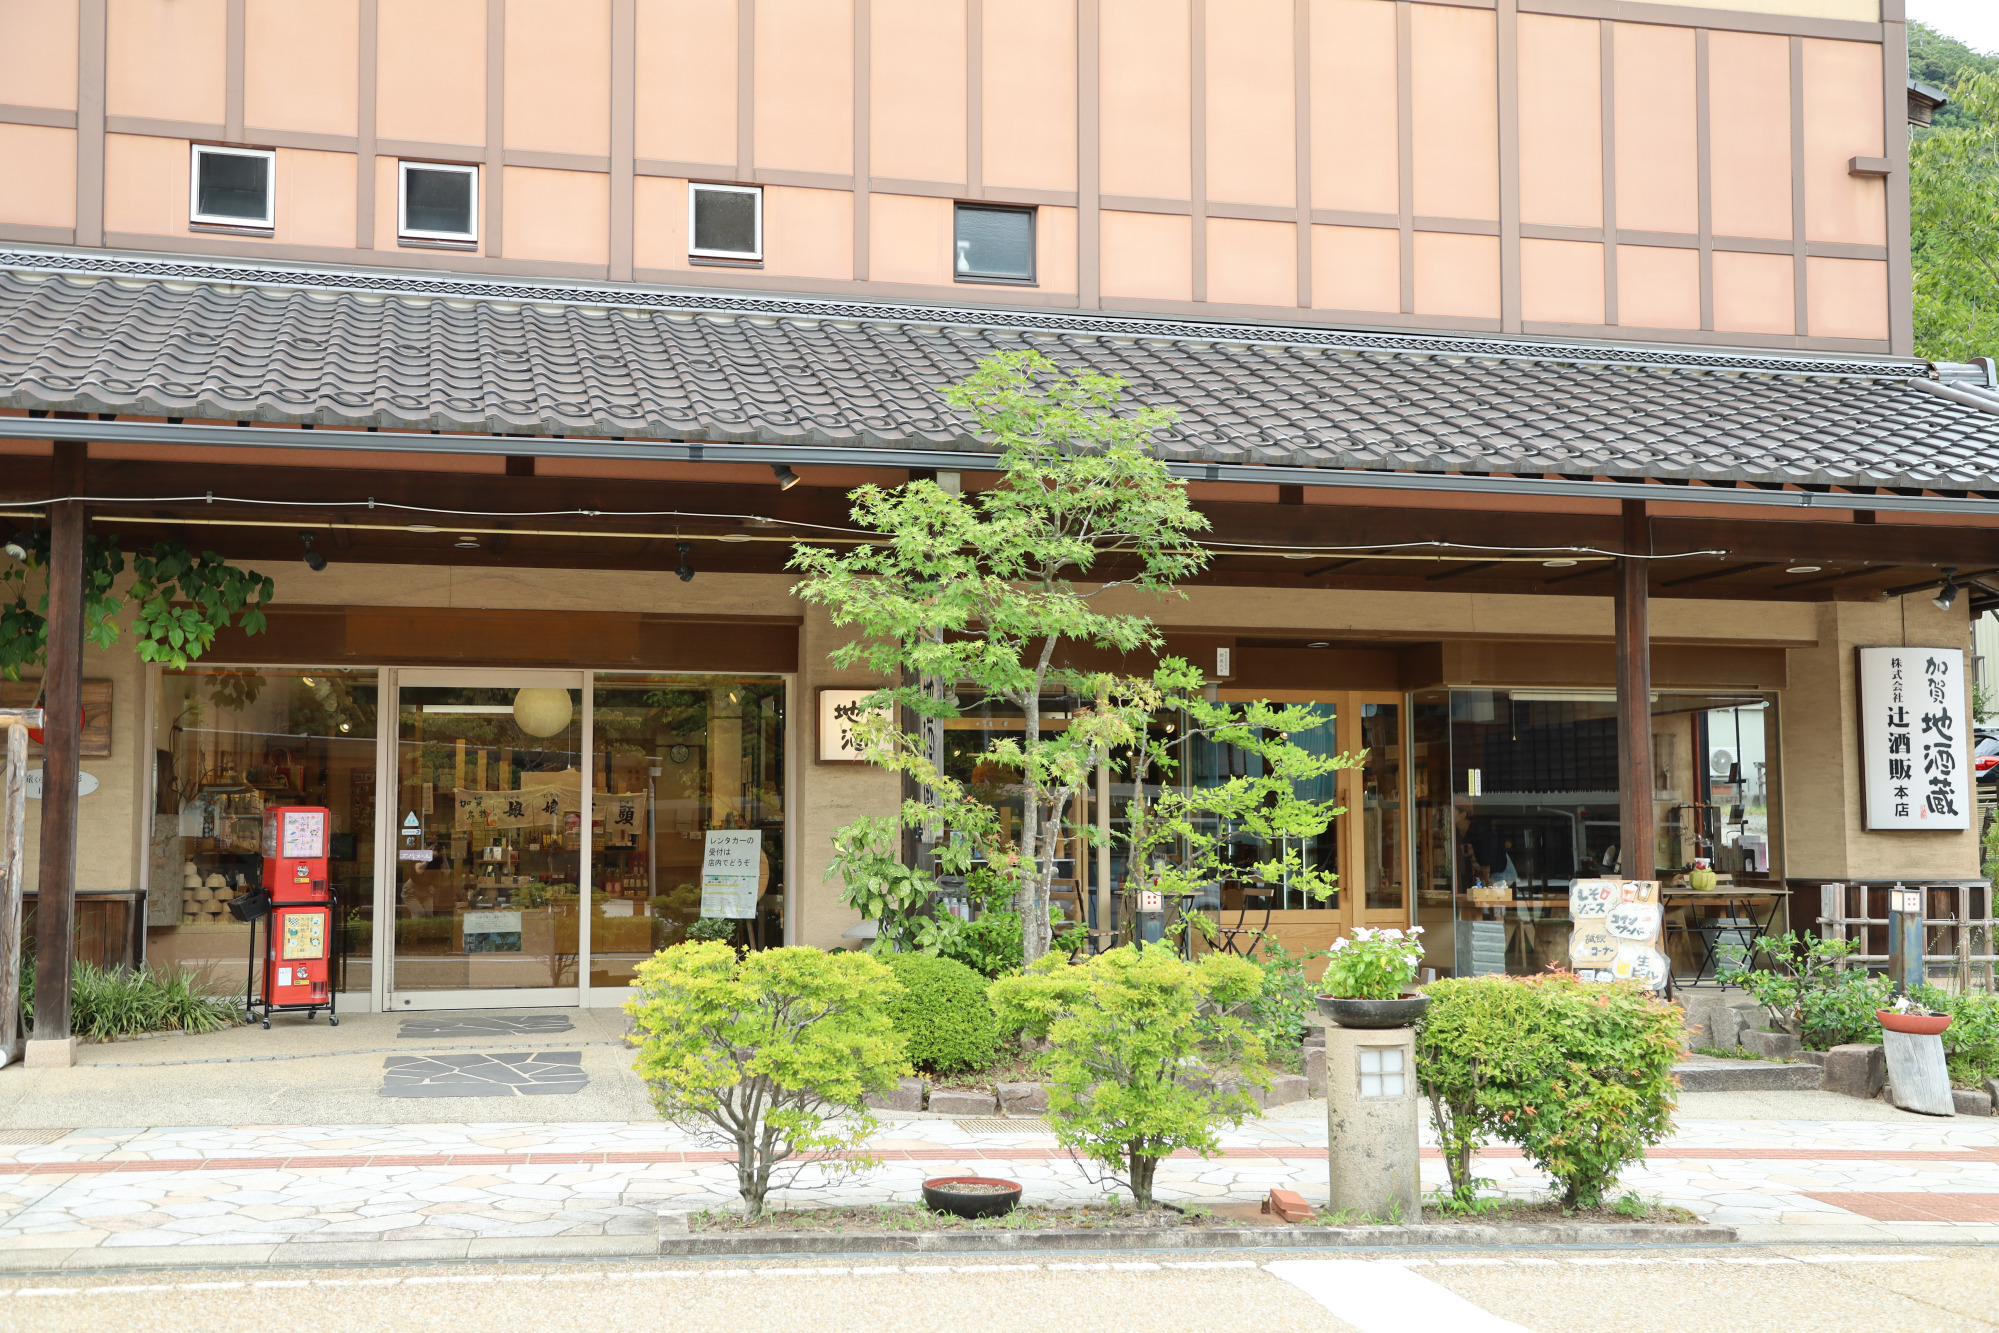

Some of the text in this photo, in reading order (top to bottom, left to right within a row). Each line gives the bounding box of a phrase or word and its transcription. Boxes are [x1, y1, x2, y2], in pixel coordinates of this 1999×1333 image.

[710, 837, 754, 845] レンタカーの
[708, 848, 731, 856] 受付は
[708, 859, 751, 867] 店内でどうぞ
[1577, 888, 1599, 901] しそ
[1577, 903, 1605, 915] ジュース
[1611, 914, 1638, 925] コイン
[1585, 934, 1607, 944] 試飲
[1591, 946, 1615, 956] コーナー
[1637, 955, 1650, 967] 生
[1632, 967, 1659, 980] ビール
